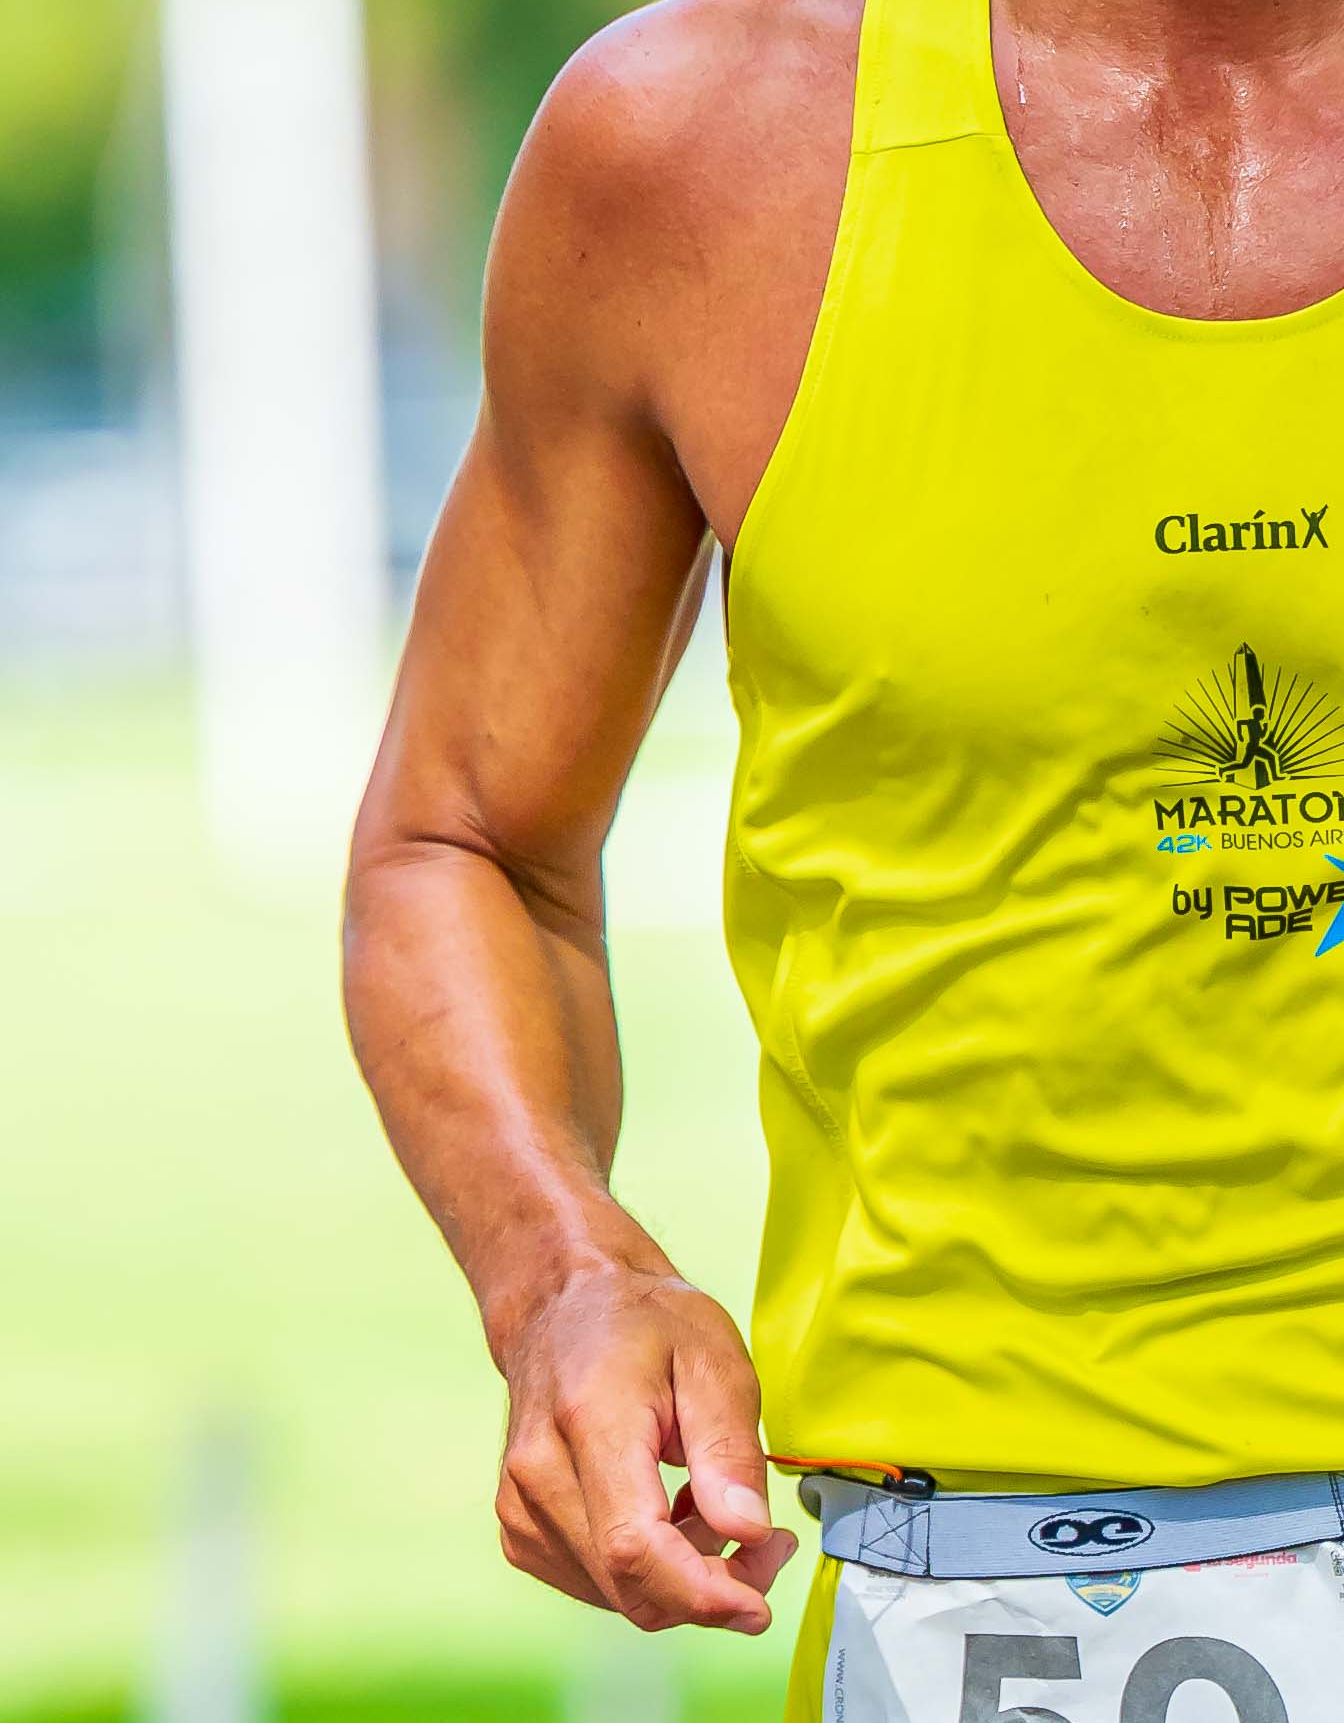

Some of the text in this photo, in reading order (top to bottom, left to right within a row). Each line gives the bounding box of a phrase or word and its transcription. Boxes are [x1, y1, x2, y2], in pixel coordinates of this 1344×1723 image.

[1154, 508, 1300, 555] Clarín
[1156, 833, 1213, 854] 42K
[1221, 830, 1304, 851] BUENOS
[1172, 883, 1213, 921] by
